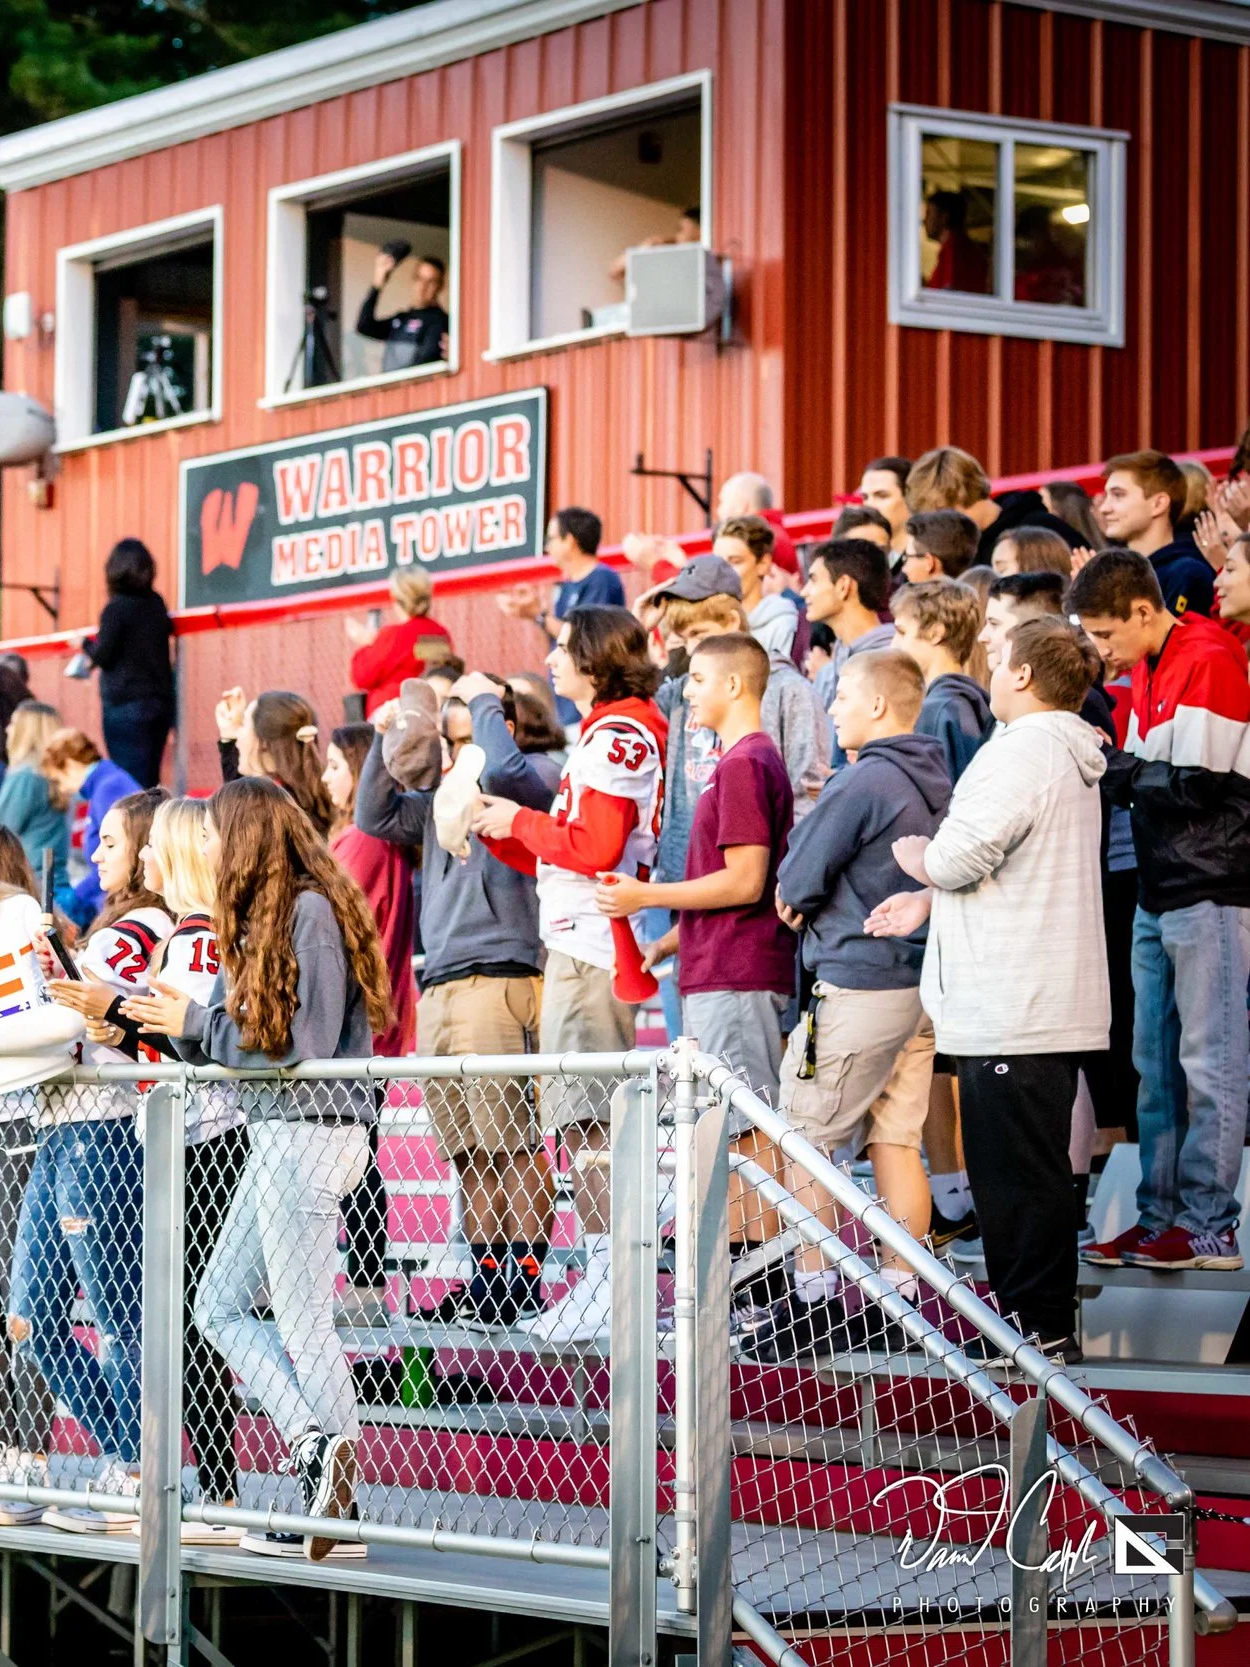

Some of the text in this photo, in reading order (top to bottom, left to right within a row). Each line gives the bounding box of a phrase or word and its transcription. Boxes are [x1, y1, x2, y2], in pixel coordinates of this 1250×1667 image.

[273, 413, 531, 525] WARRIOR
[271, 494, 527, 586] MEDIA TOWER
[607, 737, 648, 771] 53
[105, 937, 149, 983] 72
[189, 937, 221, 975] 15
